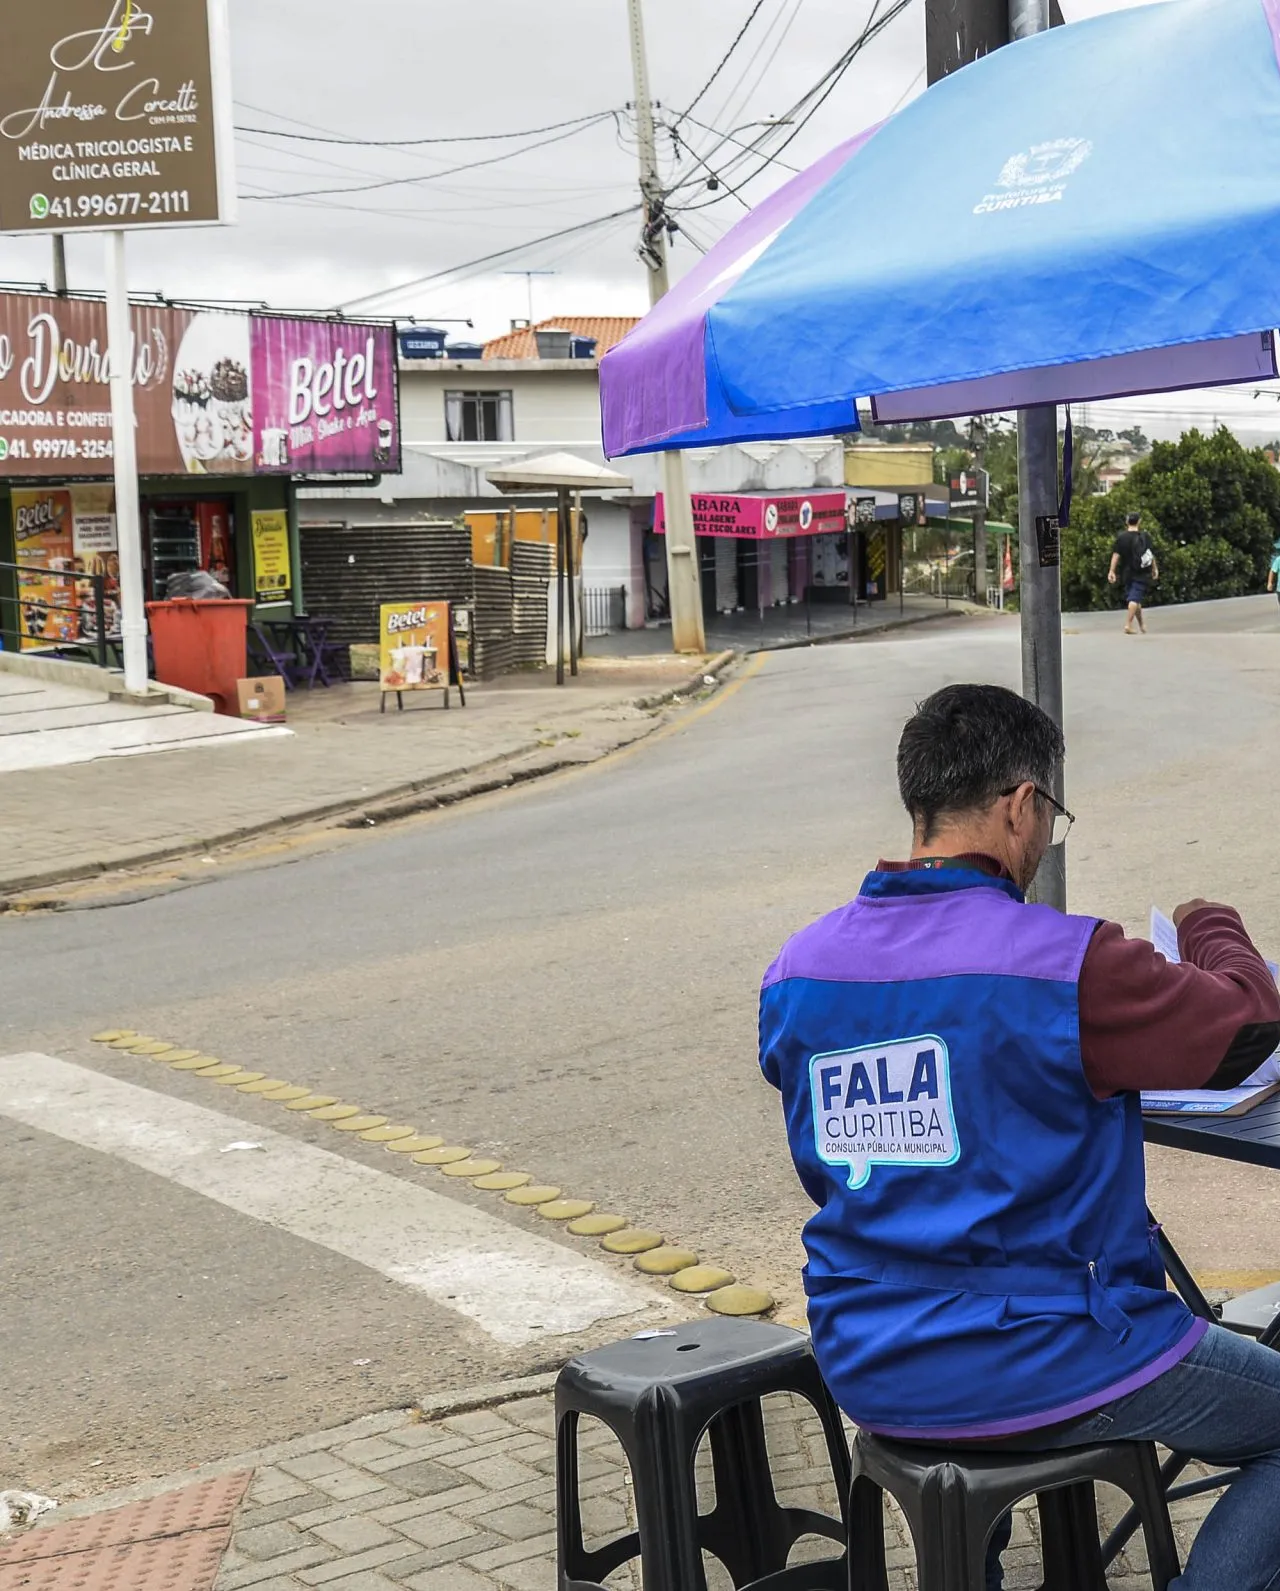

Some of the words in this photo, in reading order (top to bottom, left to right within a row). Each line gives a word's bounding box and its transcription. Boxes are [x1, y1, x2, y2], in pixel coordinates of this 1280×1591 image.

[0, 71, 107, 139] Andressa
[76, 137, 182, 158] TRICOLOGISTA
[184, 136, 193, 151] E
[52, 162, 111, 181] CLÍNICA
[112, 160, 161, 178] GERAL
[49, 190, 190, 218] 41.99677-2111
[972, 190, 1063, 215] CURITIBA
[288, 337, 377, 426] Betel
[56, 411, 64, 426] E
[15, 499, 54, 532] Betel
[387, 606, 427, 630] Betel
[820, 1048, 939, 1112] FALA
[825, 1107, 944, 1139] CURITIBA
[825, 1142, 866, 1154] CONSULTA
[867, 1139, 902, 1153] PÚBLICA
[904, 1143, 948, 1154] MUNICIPAL
